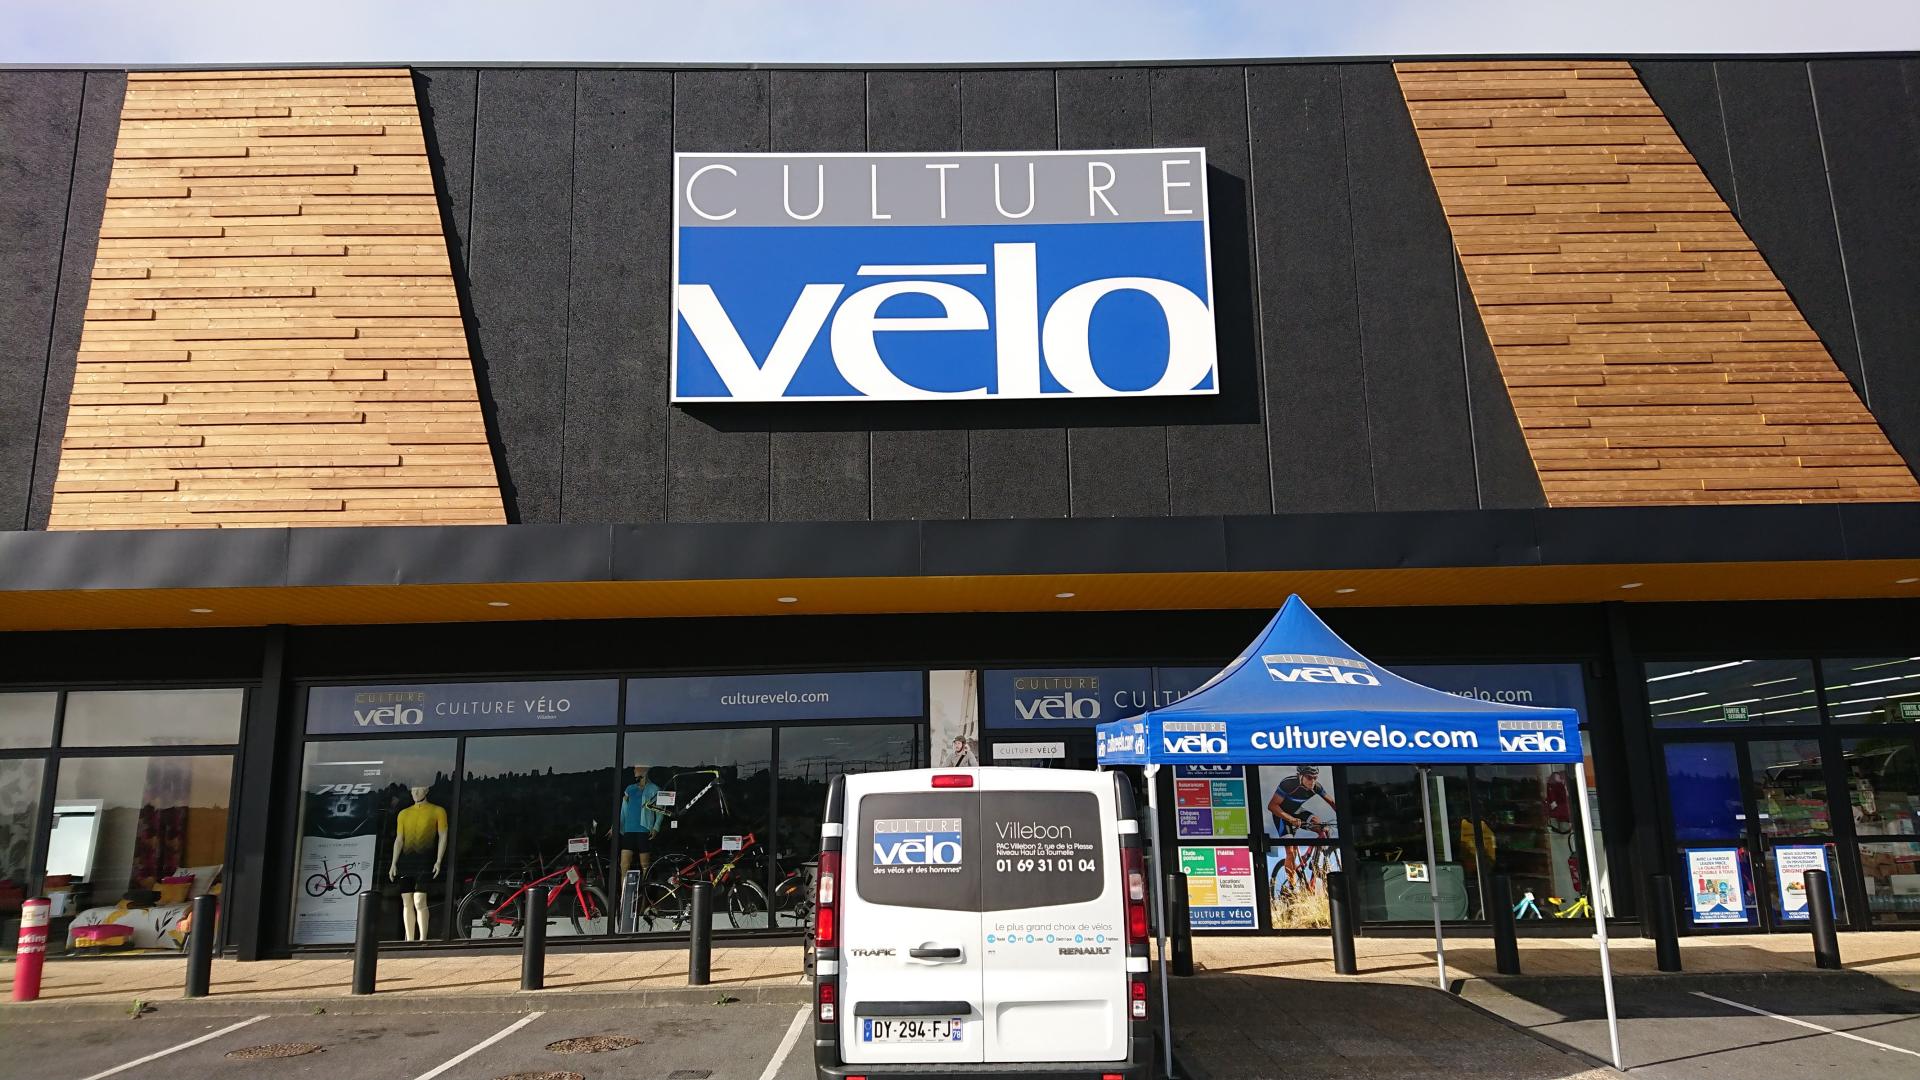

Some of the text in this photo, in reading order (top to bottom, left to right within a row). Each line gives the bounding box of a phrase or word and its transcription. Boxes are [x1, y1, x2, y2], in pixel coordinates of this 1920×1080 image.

[685, 160, 1193, 221] CULTURE
[1264, 655, 1366, 668] CULTURE
[1015, 678, 1098, 690] CULTURE
[356, 693, 424, 703] CULTURE
[720, 690, 829, 705] culturevelo.com
[435, 696, 571, 716] CULTURE VÉLO
[1163, 722, 1226, 731] CULTURE
[1499, 721, 1563, 730] CULTURE
[1250, 724, 1478, 750] culturevelo.com
[1037, 745, 1057, 754] VÉLO
[315, 783, 373, 796] 795
[685, 782, 713, 810] LOOK
[875, 820, 961, 833] CULTURE
[995, 821, 1072, 839] Villebon
[1011, 842, 1036, 851] Villebon
[996, 859, 1096, 872] 01 69 31 01 04
[1229, 909, 1252, 918] VÉLO
[995, 923, 1113, 932] Le plus grand choix de vélos
[851, 948, 896, 956] TRAFIC
[1058, 947, 1111, 955] RENAULT
[952, 1030, 961, 1039] 78
